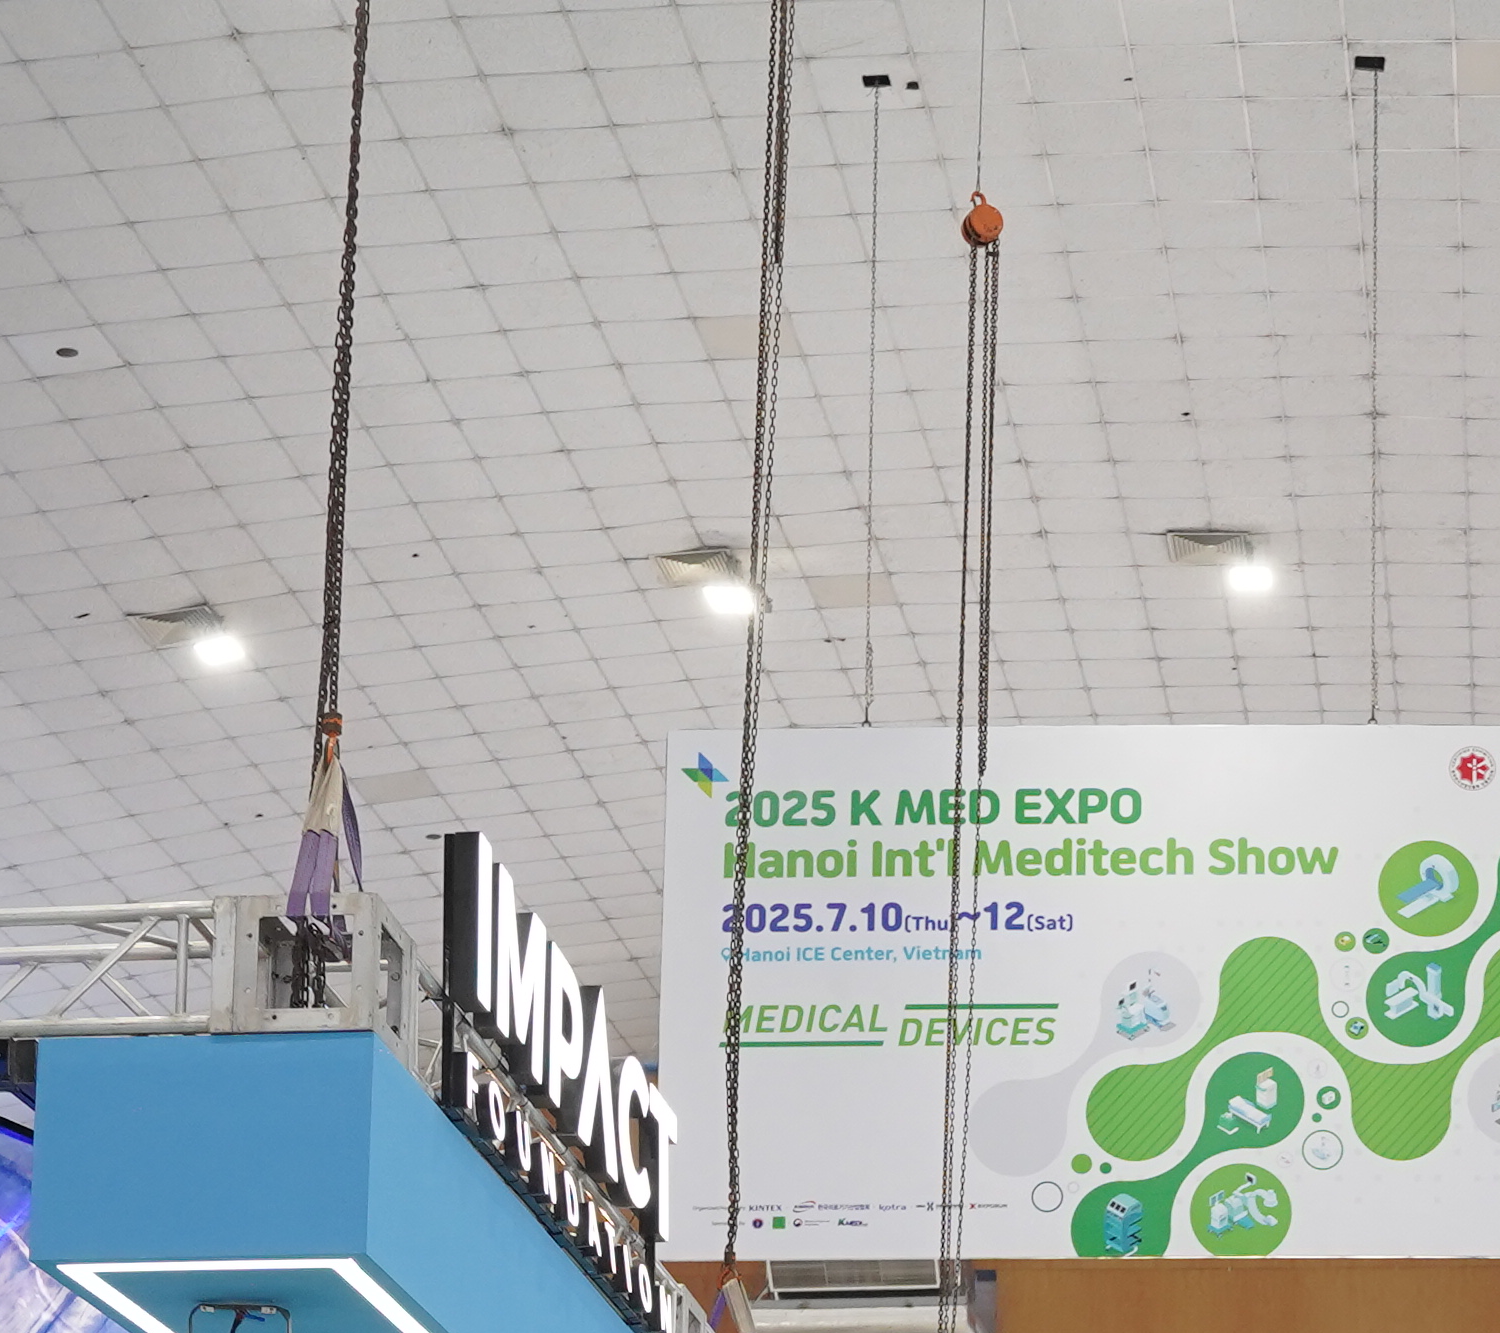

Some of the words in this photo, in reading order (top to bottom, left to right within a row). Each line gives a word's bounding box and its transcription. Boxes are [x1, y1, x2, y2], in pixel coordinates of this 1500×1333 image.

[724, 787, 835, 829] 2025
[851, 787, 883, 827] K
[895, 787, 999, 827] MED
[1016, 786, 1143, 827] EXPO
[722, 838, 858, 879] Hanoi
[871, 838, 957, 878] Int'l
[972, 837, 1195, 878] Meditech
[1208, 838, 1338, 878] Show
[740, 946, 791, 962] Hanoi
[796, 946, 825, 962] ICE
[830, 946, 897, 964] Center,
[903, 945, 982, 960] Vietnam
[472, 831, 678, 1243] IMPACT
[723, 1004, 888, 1034] MEDICAL
[898, 1017, 1057, 1048] DEVICES
